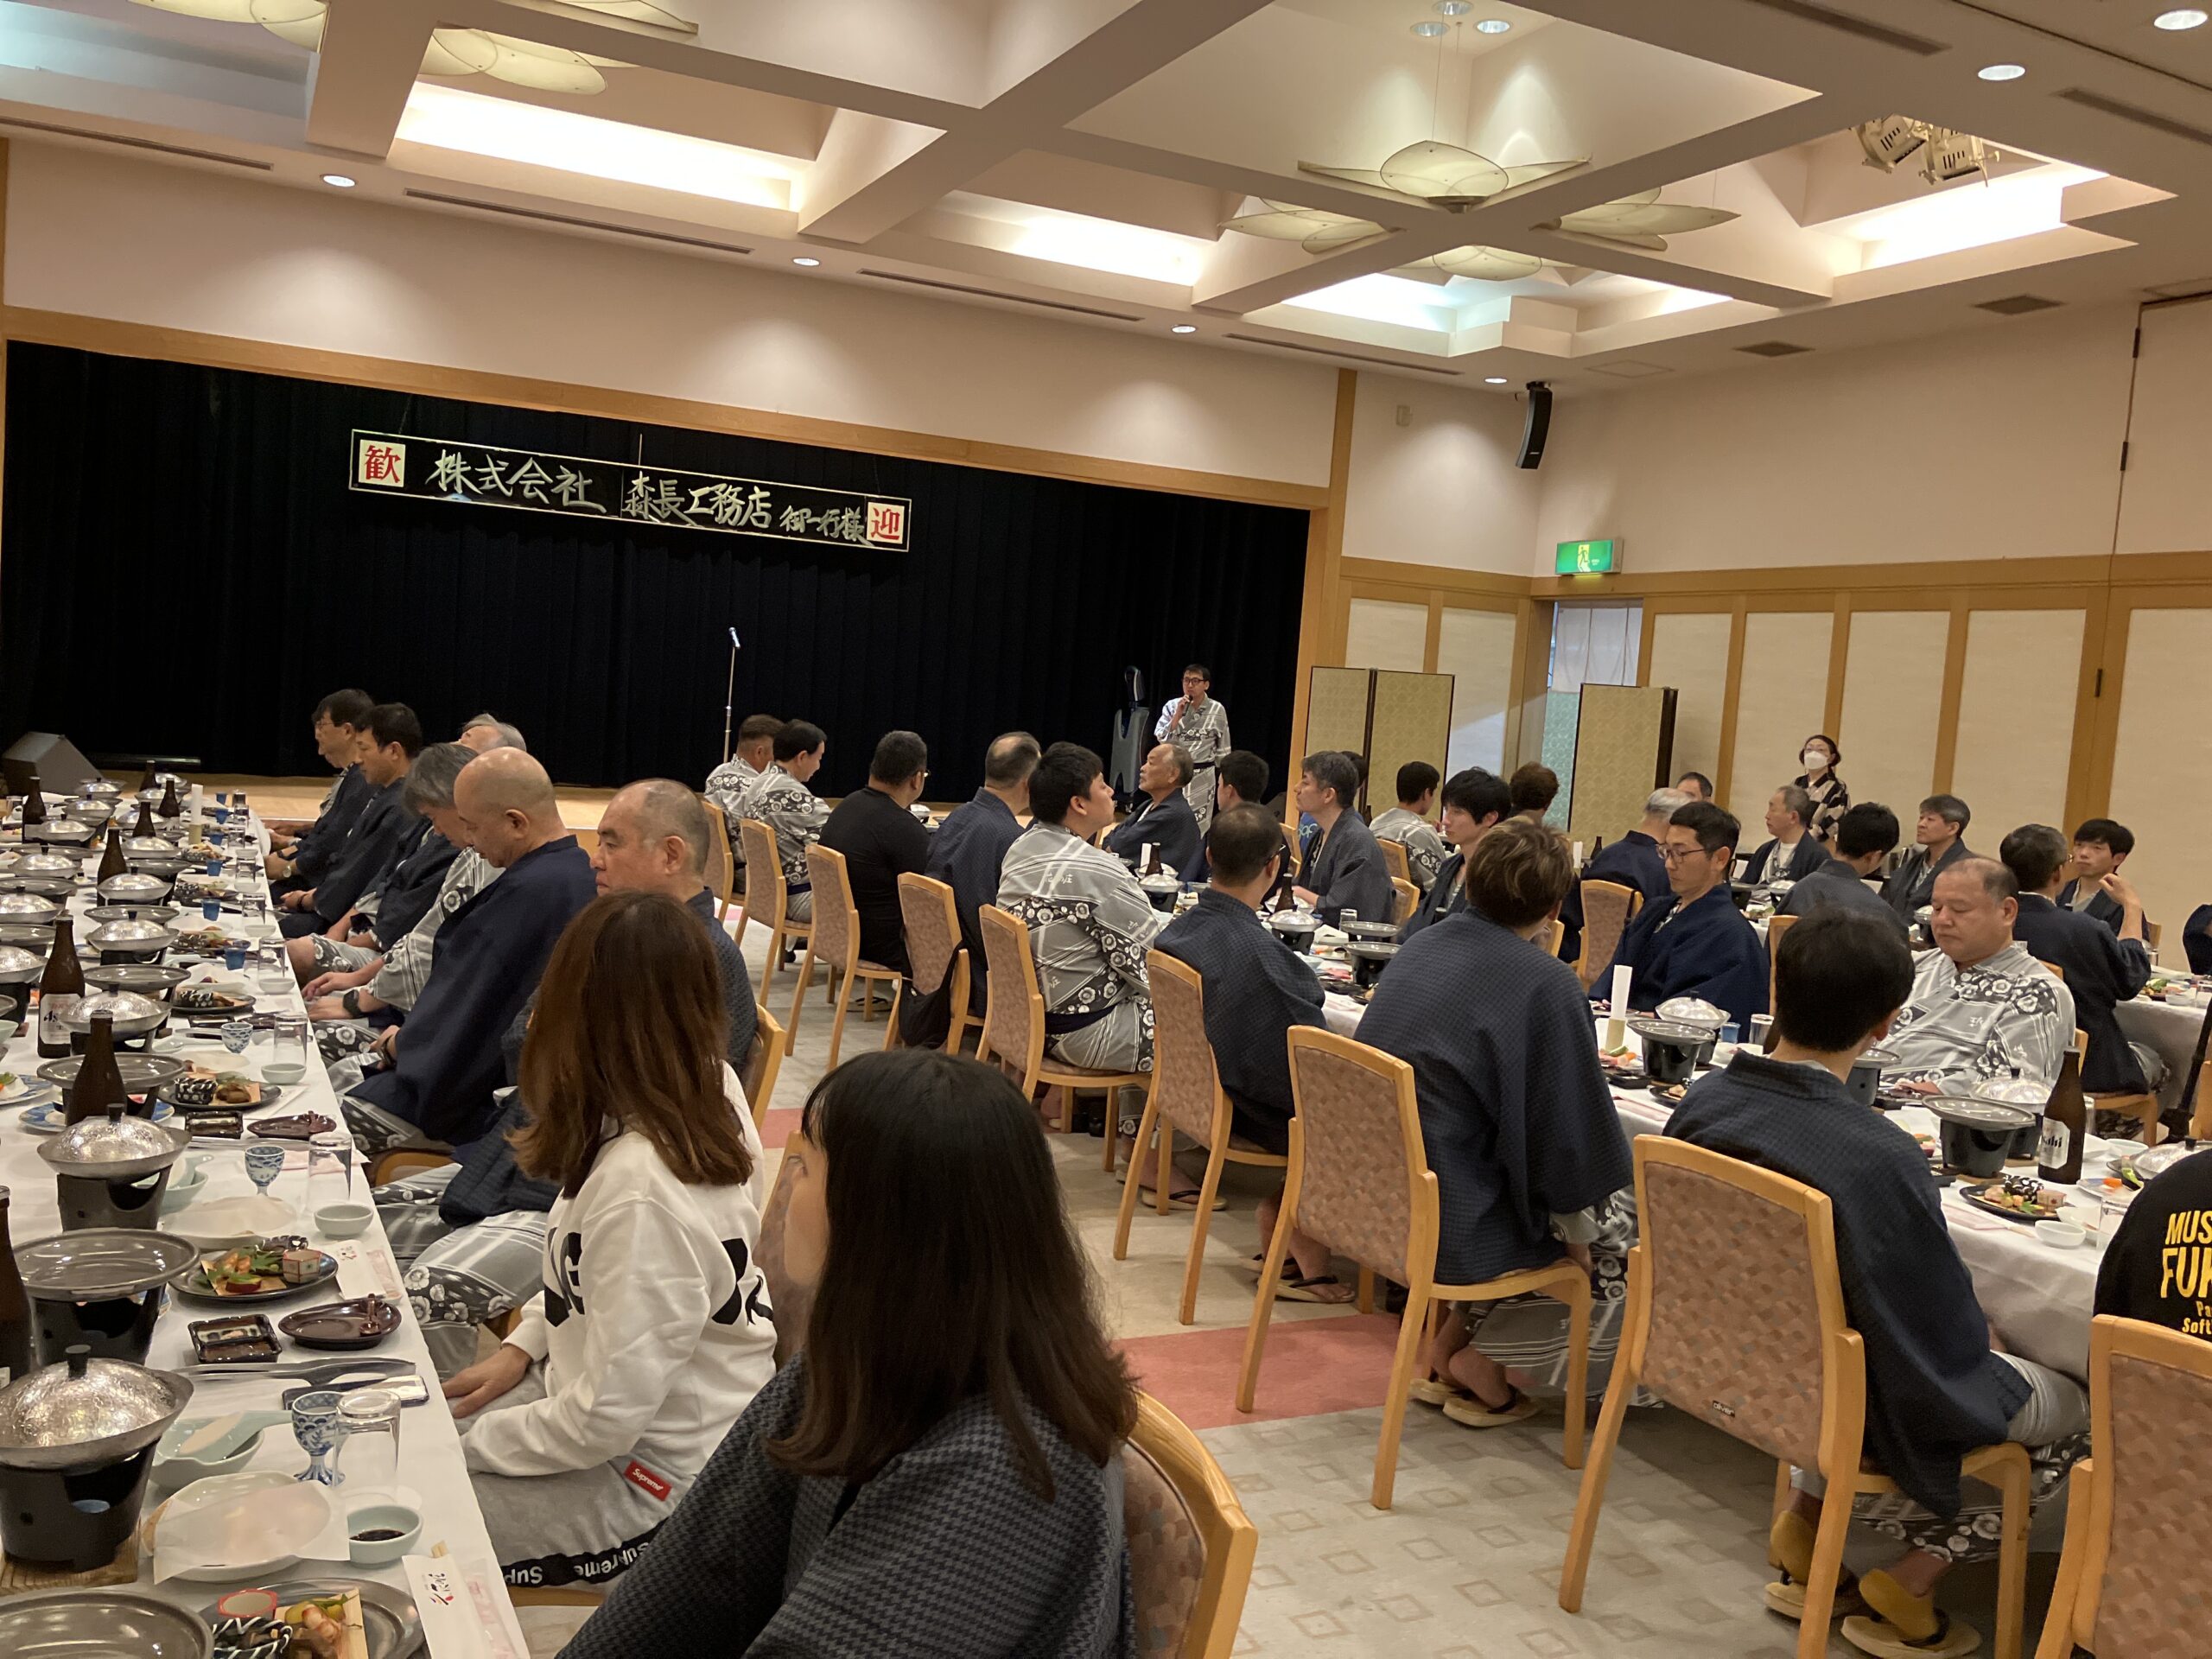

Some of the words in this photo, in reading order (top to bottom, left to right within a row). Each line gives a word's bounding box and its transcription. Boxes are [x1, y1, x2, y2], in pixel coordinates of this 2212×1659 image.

[365, 445, 401, 484] 歓
[424, 448, 607, 513] 株式会社
[779, 505, 875, 547] 御一行様
[870, 508, 899, 540] 迎
[632, 1468, 664, 1491] Supreme
